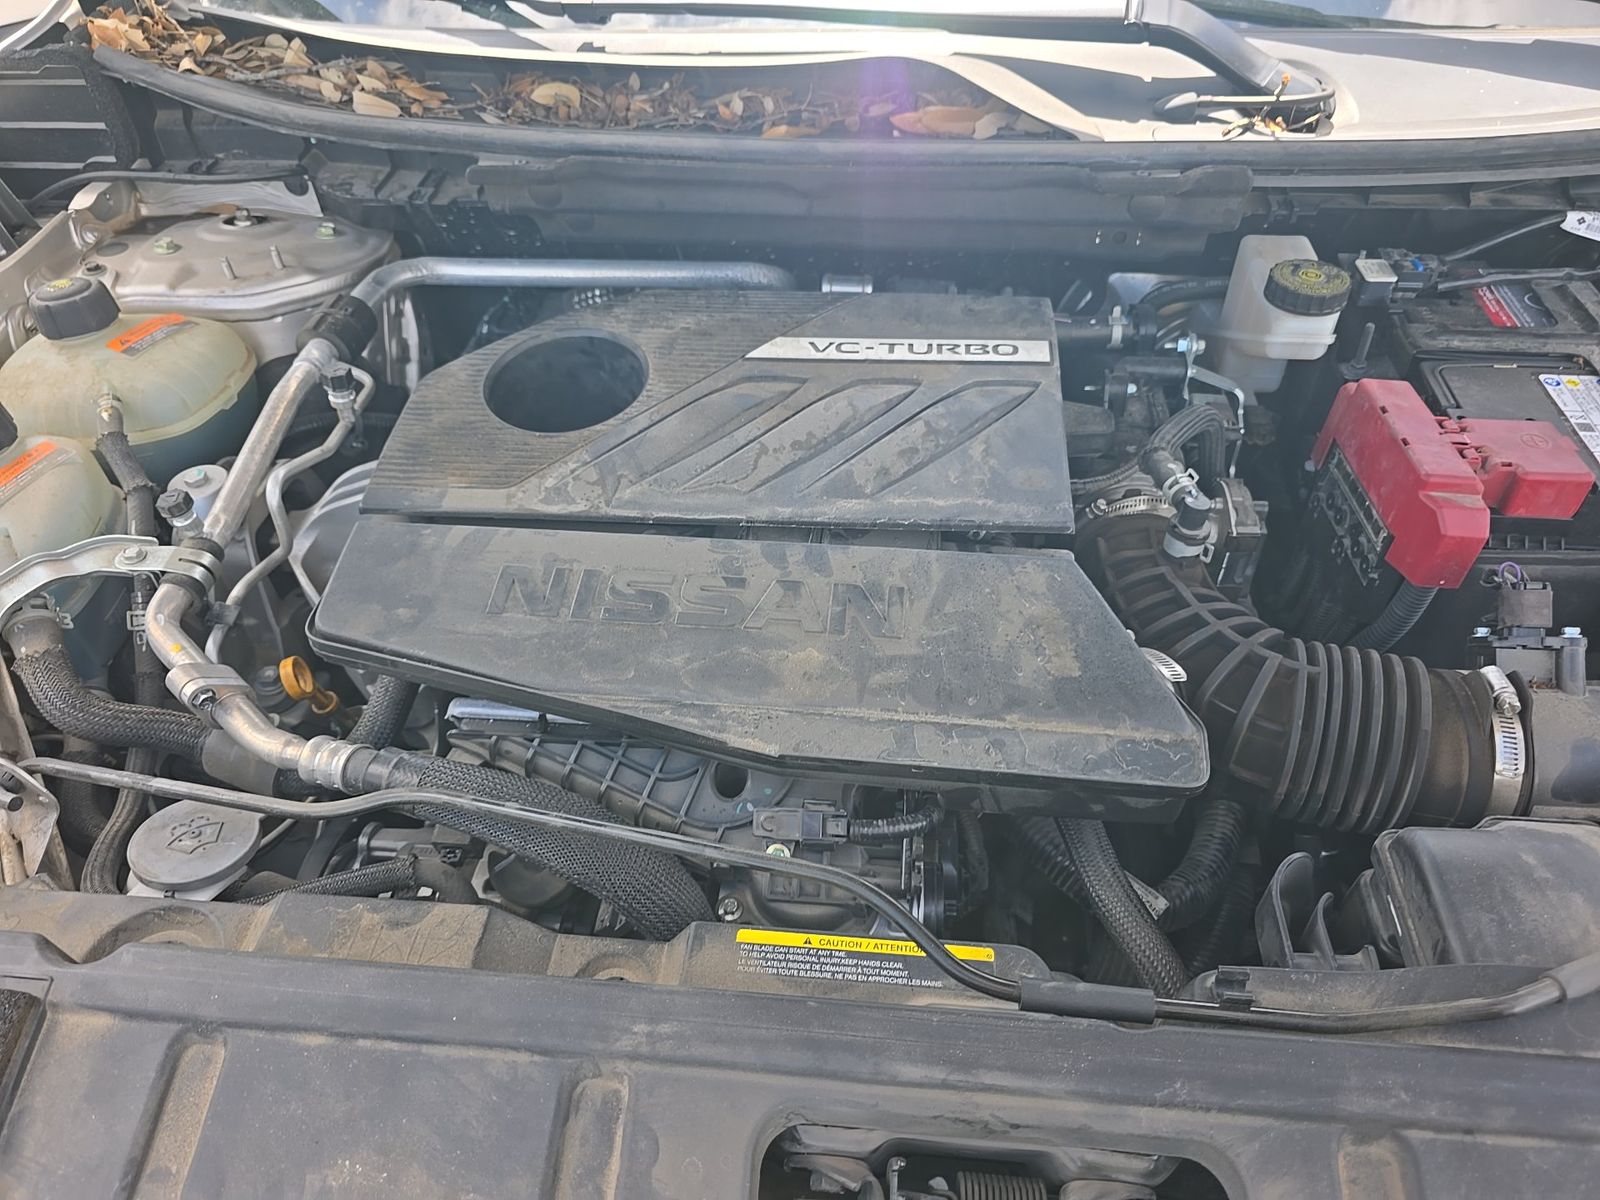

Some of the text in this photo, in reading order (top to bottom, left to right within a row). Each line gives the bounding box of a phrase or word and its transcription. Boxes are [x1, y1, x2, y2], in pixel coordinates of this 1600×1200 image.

[808, 341, 1019, 356] VC-TURBO
[485, 564, 908, 639] NISSAN
[819, 938, 862, 949] CAUTION
[873, 943, 923, 954] ATTENTIO
[786, 954, 819, 962] PERSONAL
[818, 949, 831, 957] ANY
[748, 959, 787, 968] VENTILATEUR
[868, 975, 908, 985] APPROCHER
